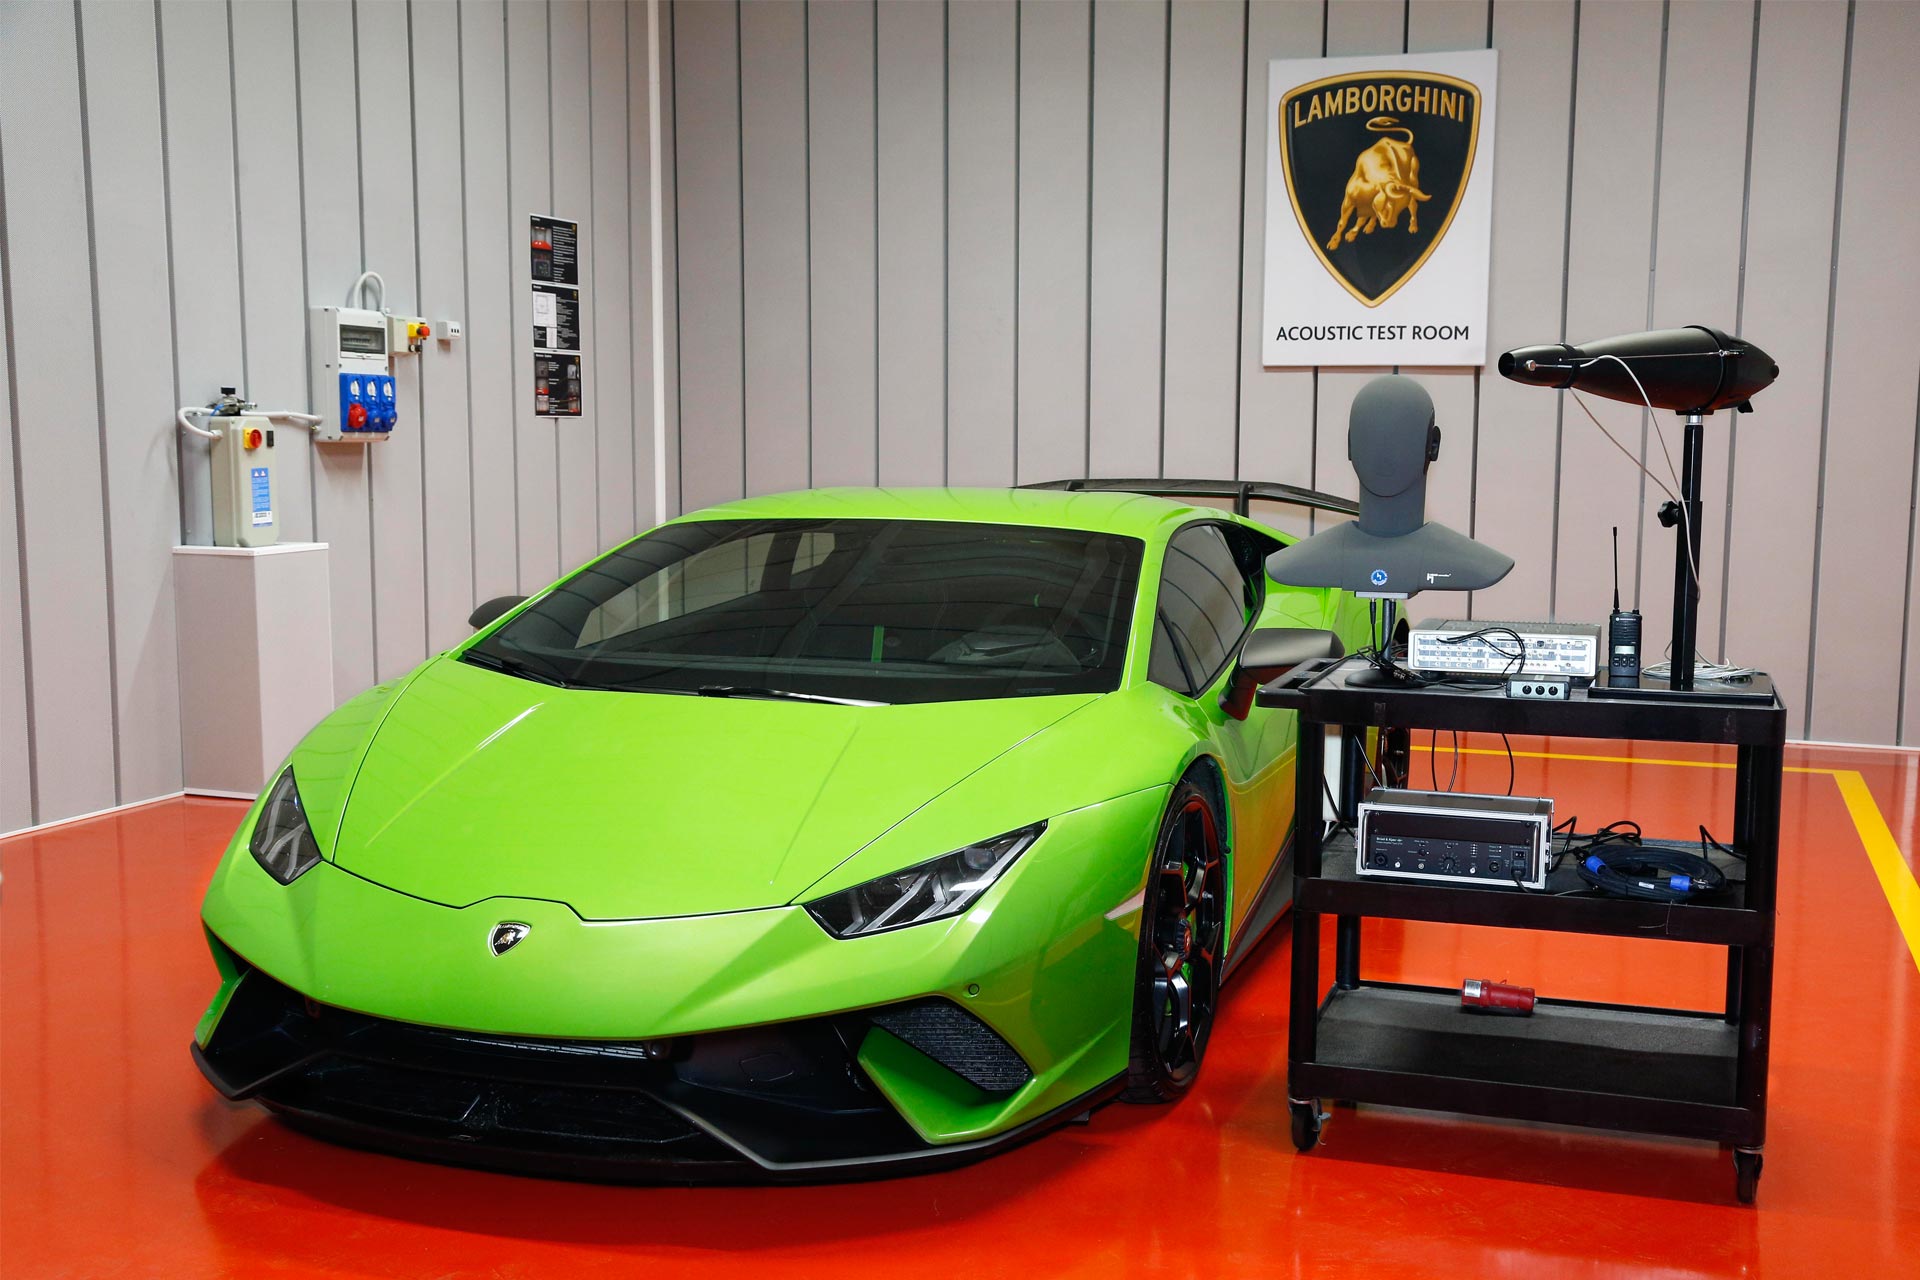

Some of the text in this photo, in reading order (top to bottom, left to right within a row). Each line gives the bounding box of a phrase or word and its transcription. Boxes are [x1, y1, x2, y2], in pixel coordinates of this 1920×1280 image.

[1294, 84, 1465, 129] LAMBORGHINI
[1276, 325, 1469, 341] ACOUSTIC TEST ROOM
